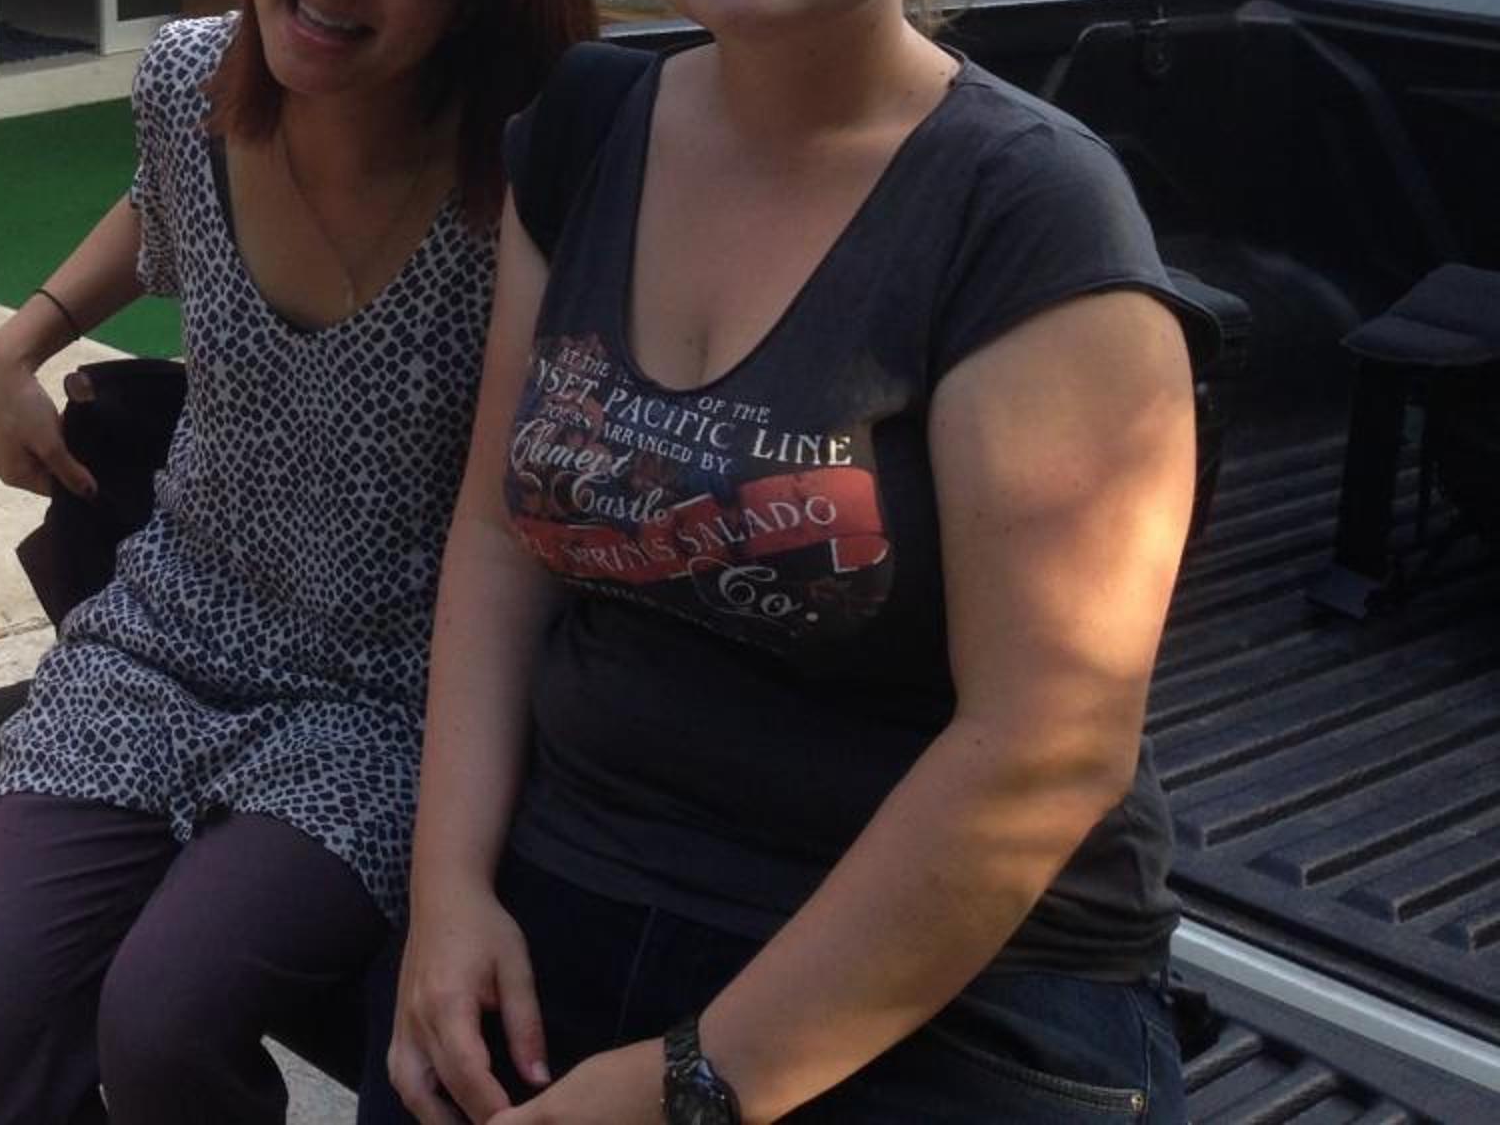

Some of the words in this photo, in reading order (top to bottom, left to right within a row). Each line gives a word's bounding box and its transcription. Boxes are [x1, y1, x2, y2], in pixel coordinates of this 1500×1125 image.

[601, 385, 738, 451] PACIFIC
[751, 427, 853, 467] LINE
[698, 395, 727, 415] OF
[733, 402, 772, 425] THE
[602, 421, 694, 463] ARRANGED
[701, 451, 733, 475] BY
[571, 471, 670, 527] Castle
[676, 495, 837, 556] SALADO
